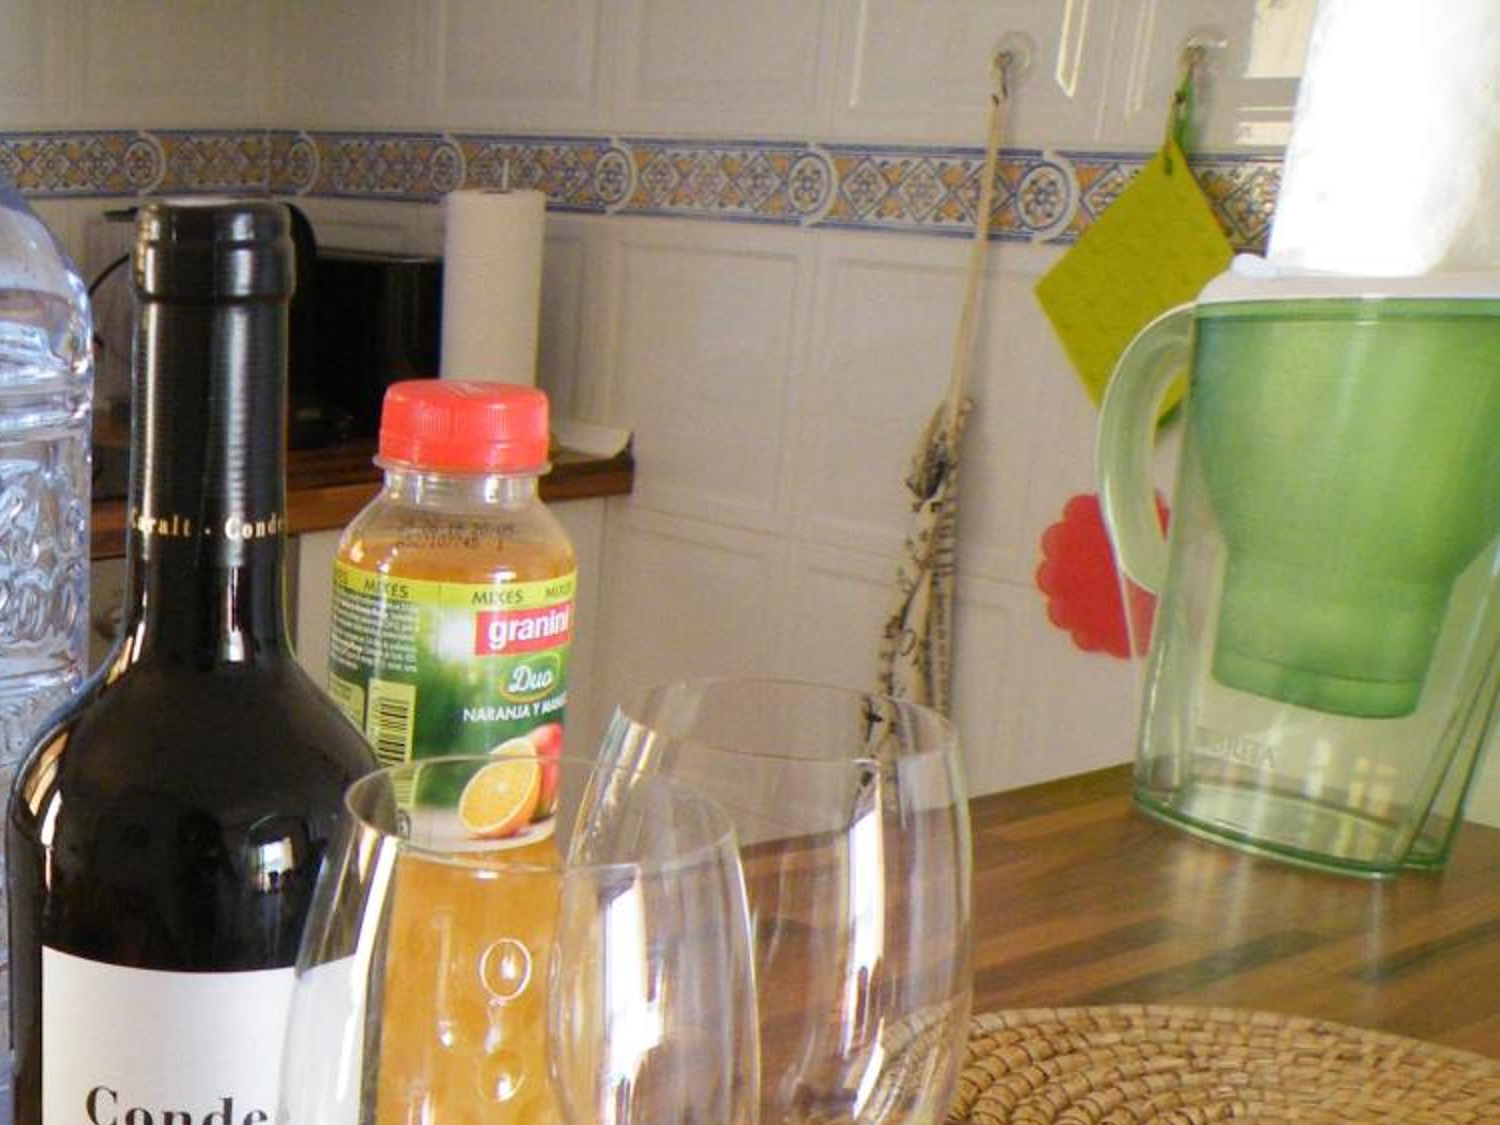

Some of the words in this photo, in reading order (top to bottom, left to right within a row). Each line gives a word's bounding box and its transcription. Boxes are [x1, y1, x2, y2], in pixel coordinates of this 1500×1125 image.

[363, 577, 409, 599] MES
[470, 589, 524, 606] MIES
[508, 664, 554, 693] Duo
[462, 702, 531, 721] NARANJA
